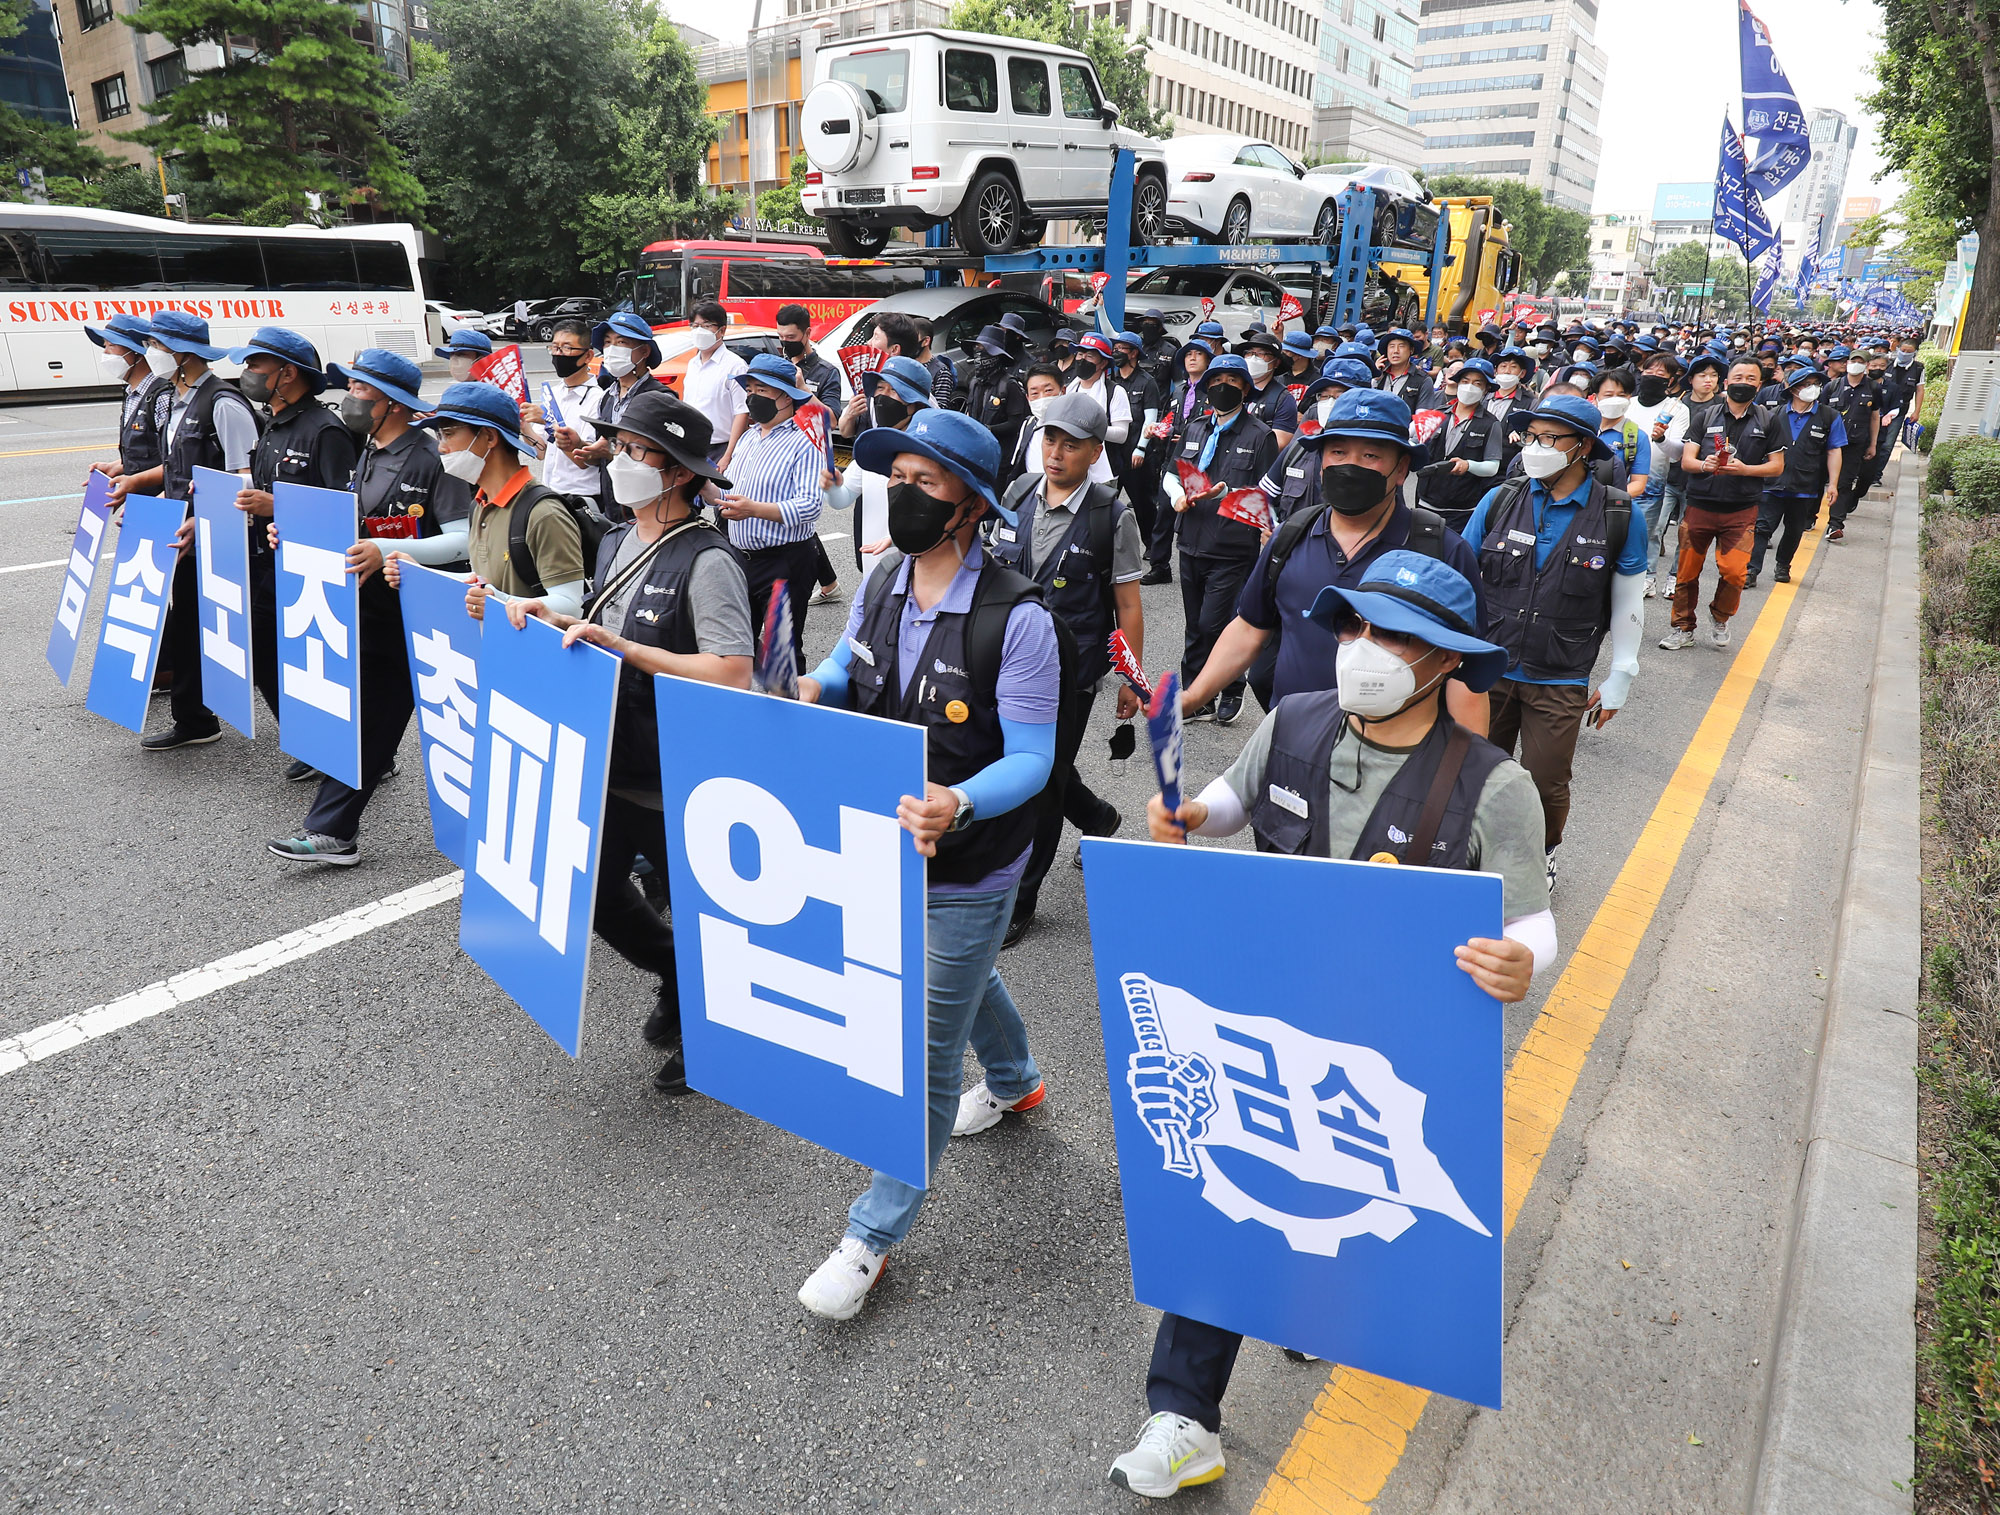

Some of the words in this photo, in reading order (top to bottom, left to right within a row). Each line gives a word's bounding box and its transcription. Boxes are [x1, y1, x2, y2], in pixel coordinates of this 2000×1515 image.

[776, 219, 789, 233] La
[792, 222, 813, 236] TREE
[1219, 248, 1281, 260] M&M통운(주)
[8, 300, 89, 323] SUNG
[217, 299, 285, 319] TOUR
[329, 300, 390, 316] 신성관광
[57, 506, 104, 641] 금
[103, 538, 166, 682] 속
[199, 517, 246, 680] 노
[282, 540, 351, 722] 조
[412, 627, 478, 819] 총
[475, 687, 590, 956] 파
[683, 776, 904, 1097] 업
[1215, 1022, 1401, 1195] 금속
